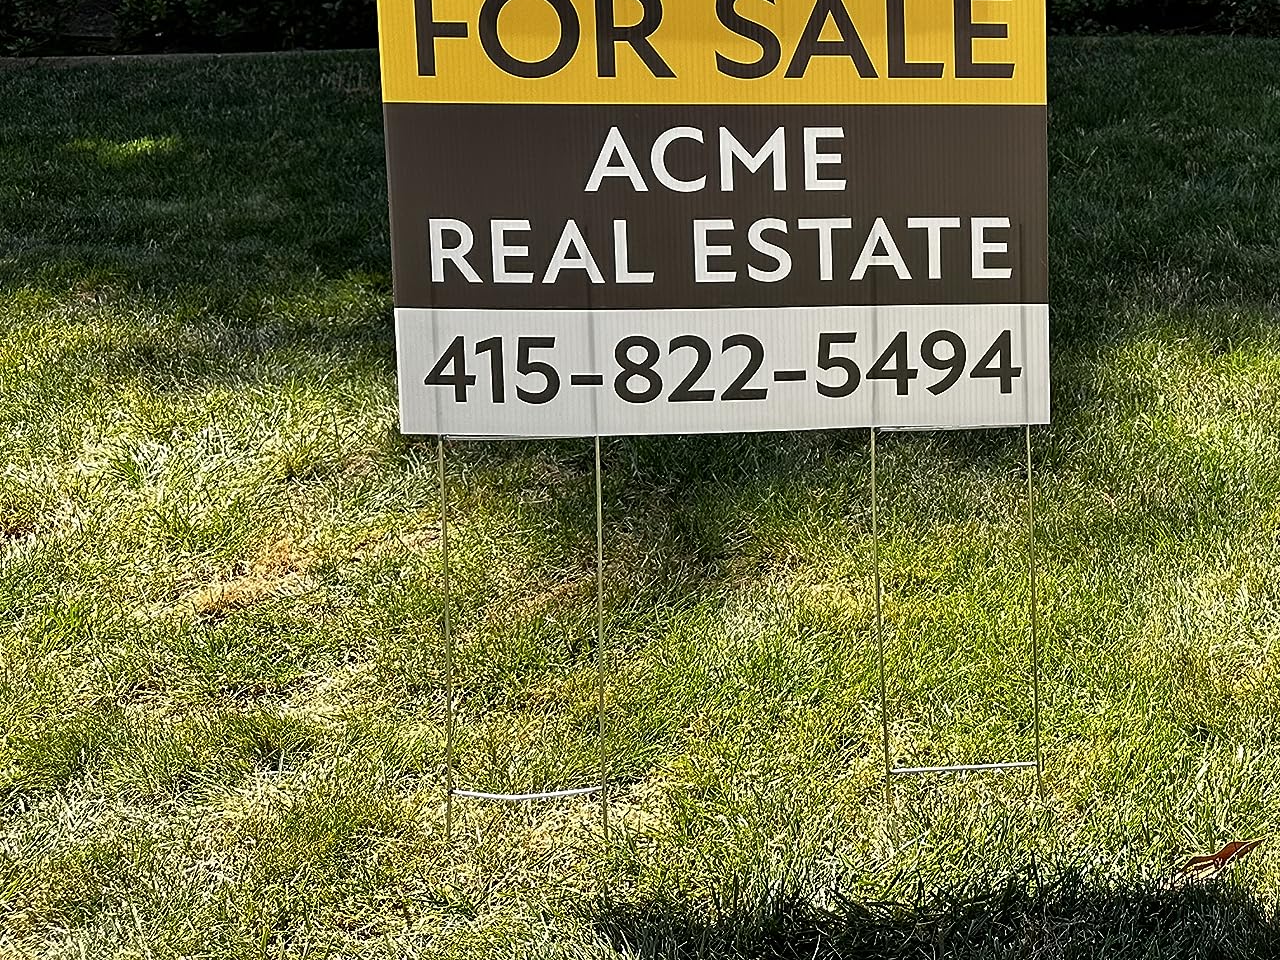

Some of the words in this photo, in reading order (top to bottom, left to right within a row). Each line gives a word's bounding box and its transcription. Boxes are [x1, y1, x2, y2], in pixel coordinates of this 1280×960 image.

[584, 126, 848, 193] ACME
[428, 217, 654, 284] REAL
[693, 216, 1014, 282] ESTATE
[424, 329, 1022, 405] 415-822-5494
